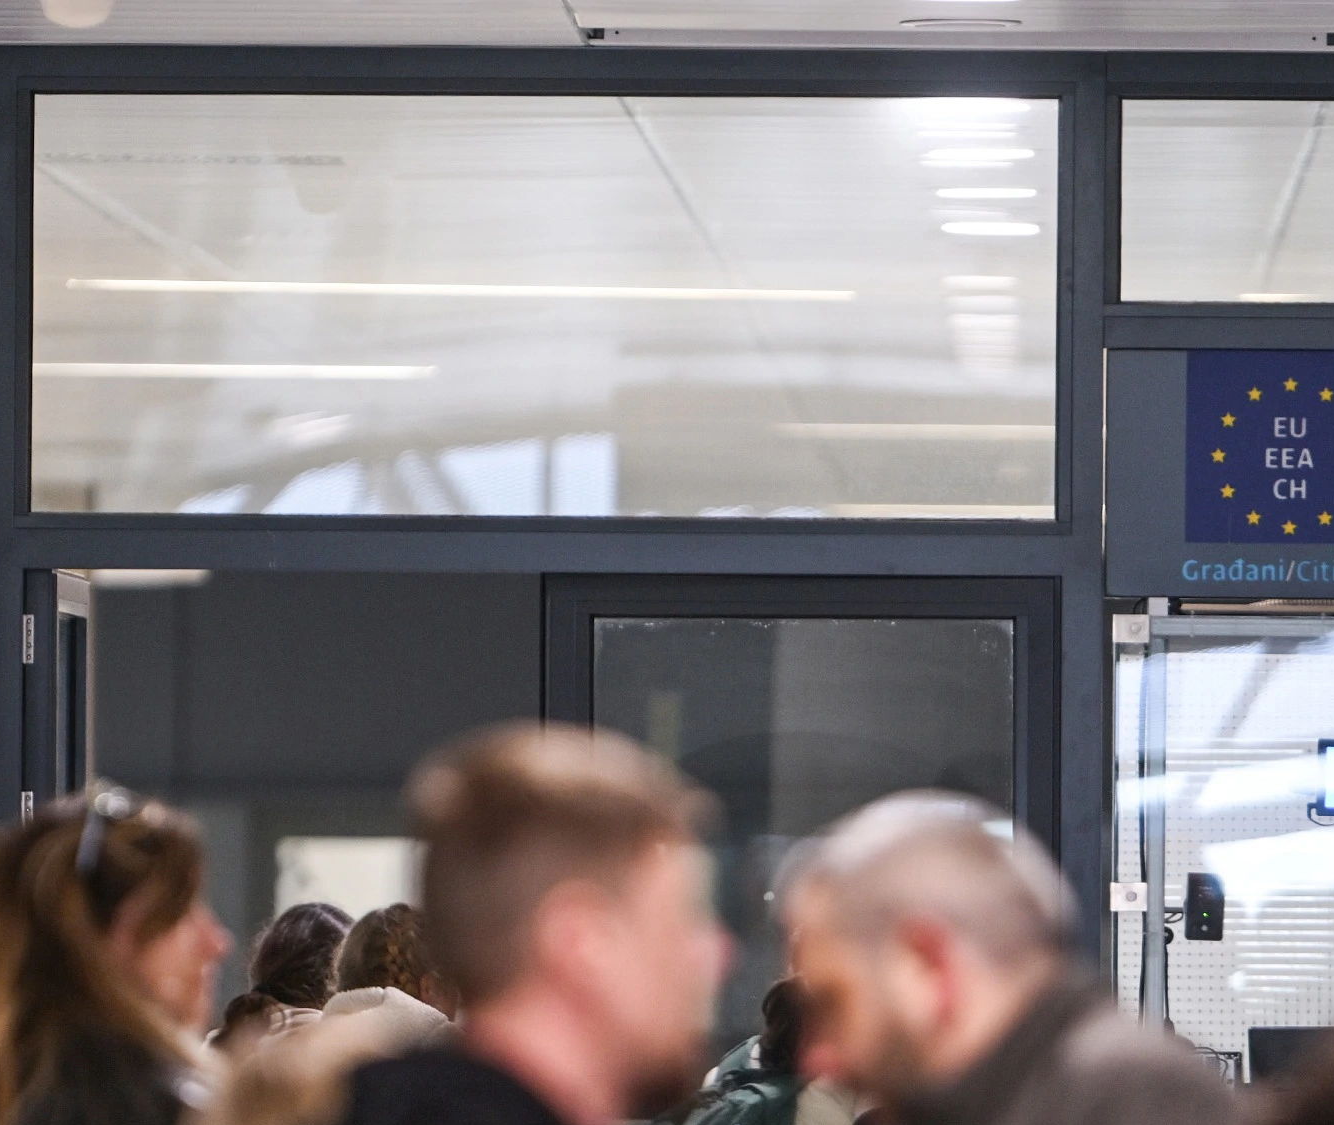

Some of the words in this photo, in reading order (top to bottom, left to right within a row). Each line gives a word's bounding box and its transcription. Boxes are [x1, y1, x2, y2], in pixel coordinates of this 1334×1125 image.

[1275, 417, 1306, 437] EU
[1266, 448, 1313, 468] EEA
[1274, 479, 1306, 499] CH
